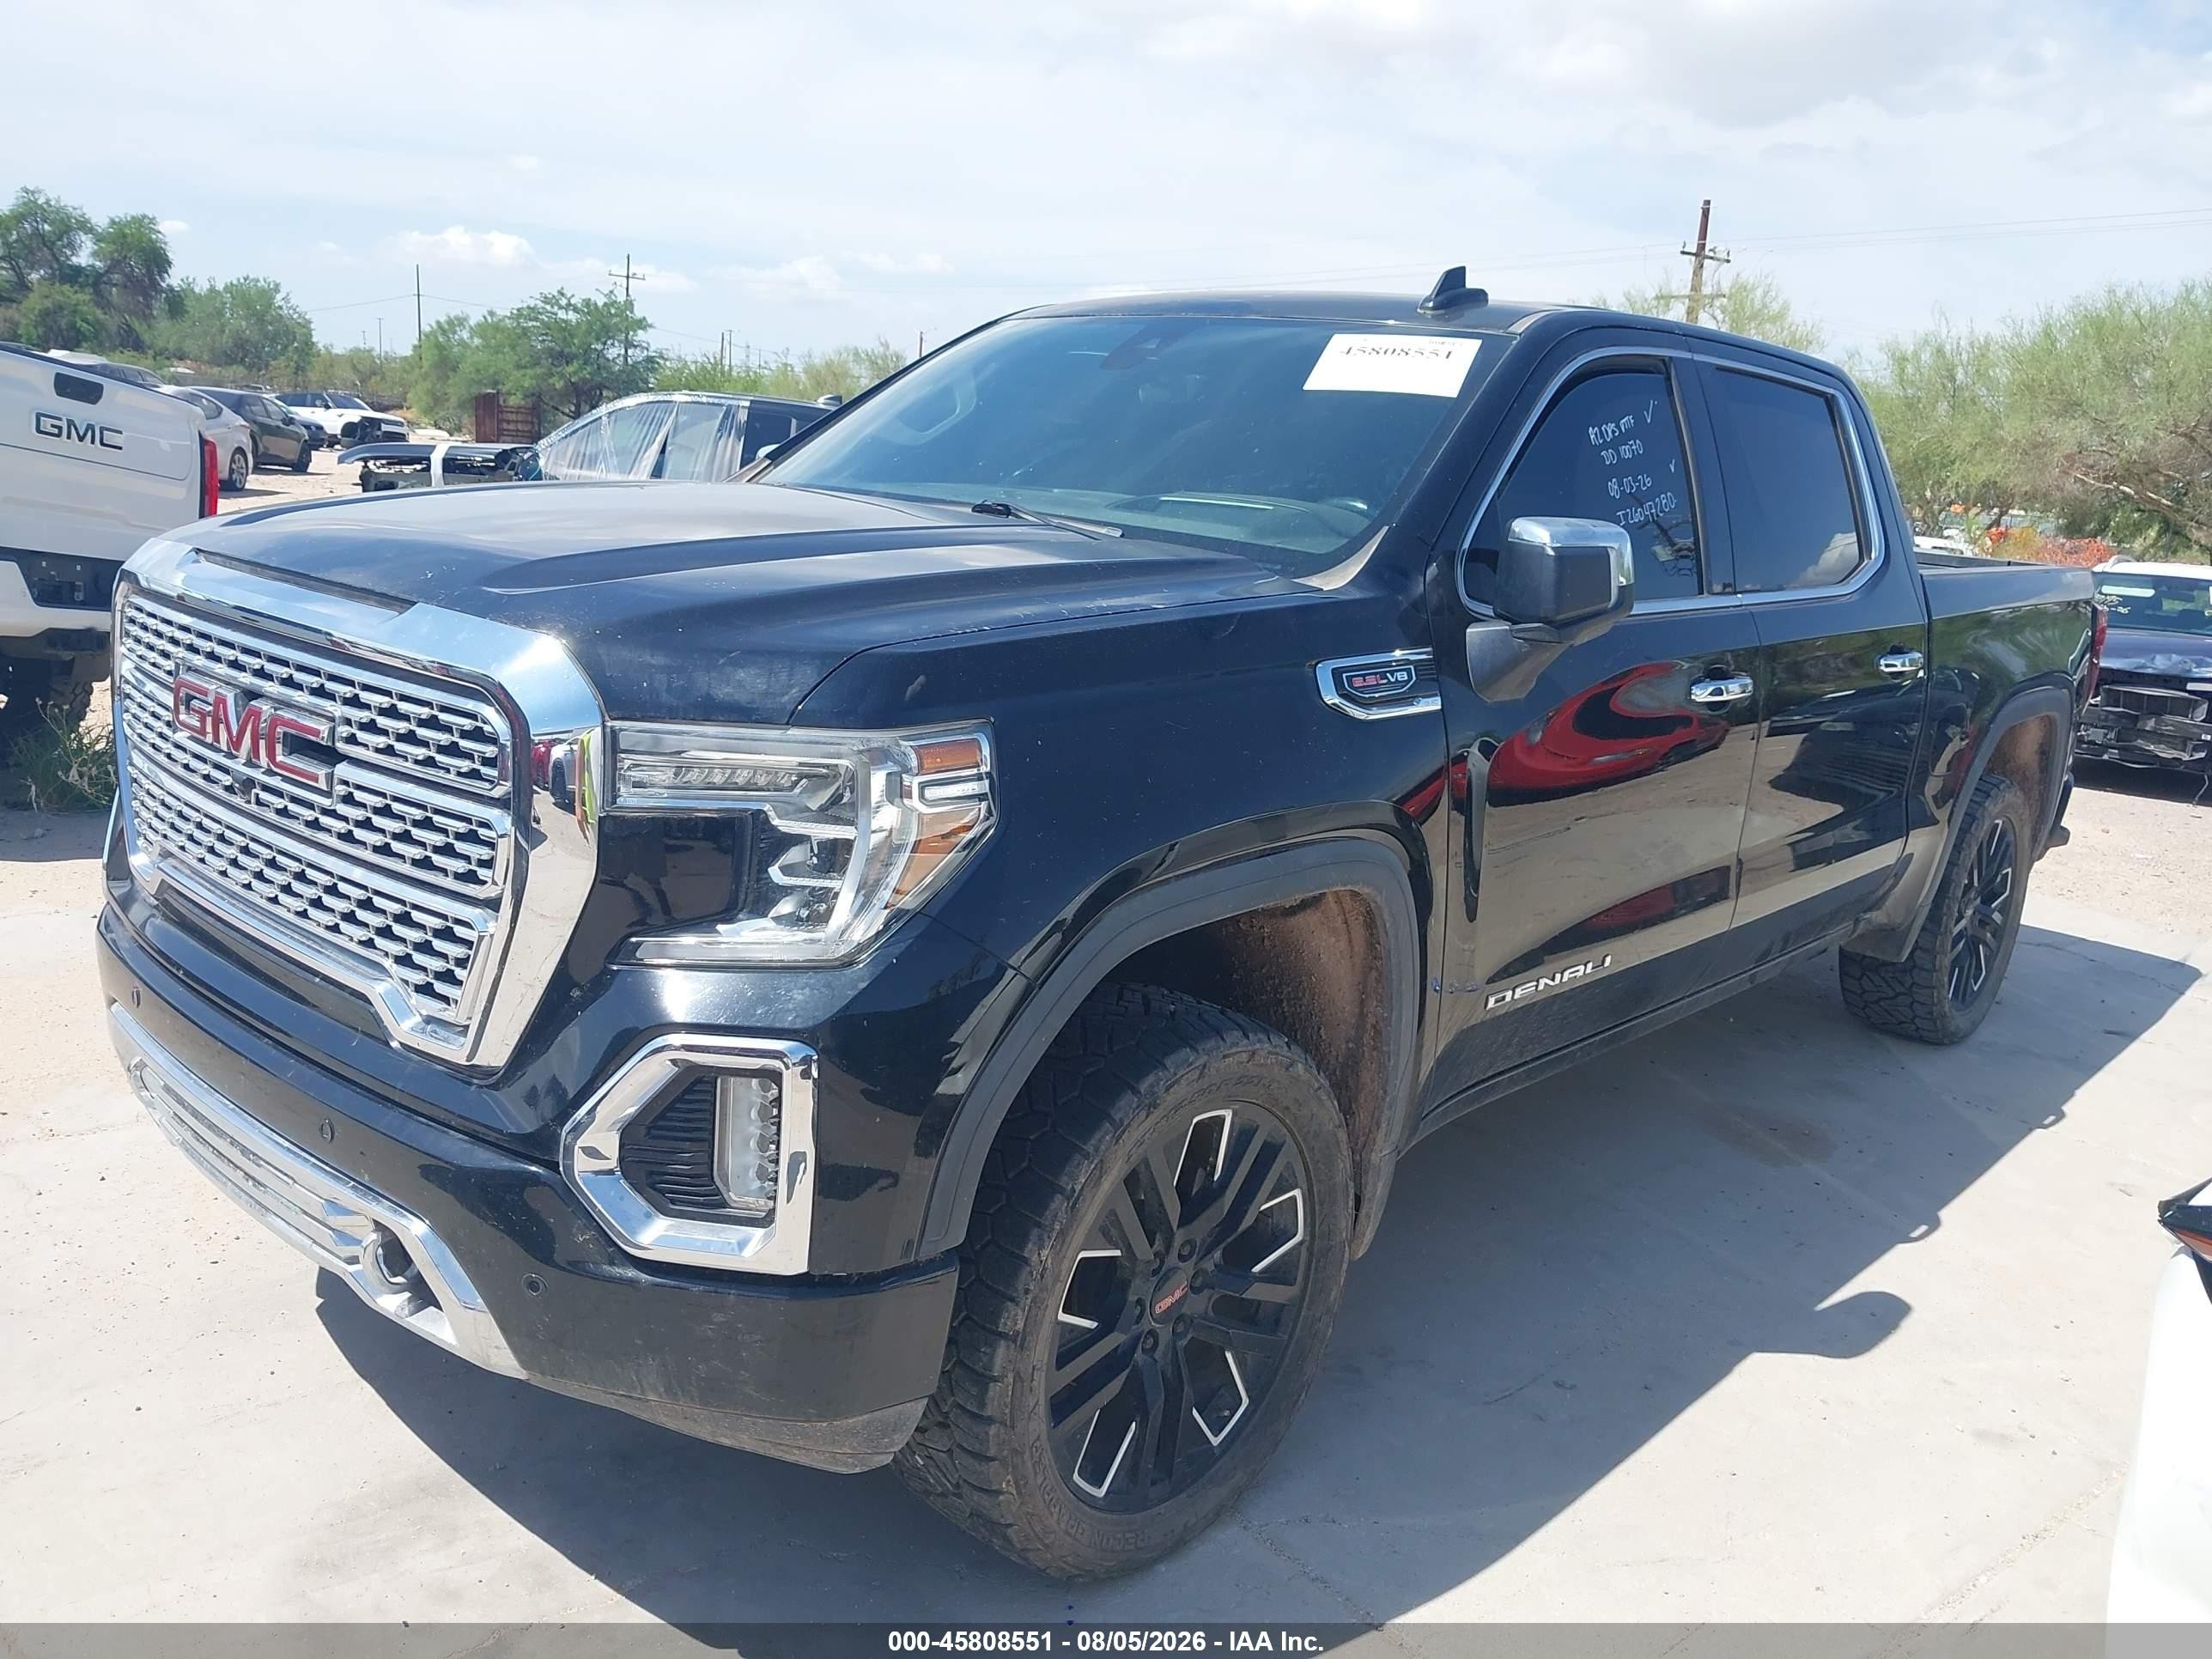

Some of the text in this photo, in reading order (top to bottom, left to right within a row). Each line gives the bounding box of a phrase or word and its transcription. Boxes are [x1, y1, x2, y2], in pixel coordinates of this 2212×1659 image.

[34, 411, 124, 451] GMC
[1607, 473, 1652, 499] 08-03-26
[172, 672, 335, 791] GMC
[1484, 953, 1612, 1011] DENALI
[1155, 1278, 1188, 1314] GMC
